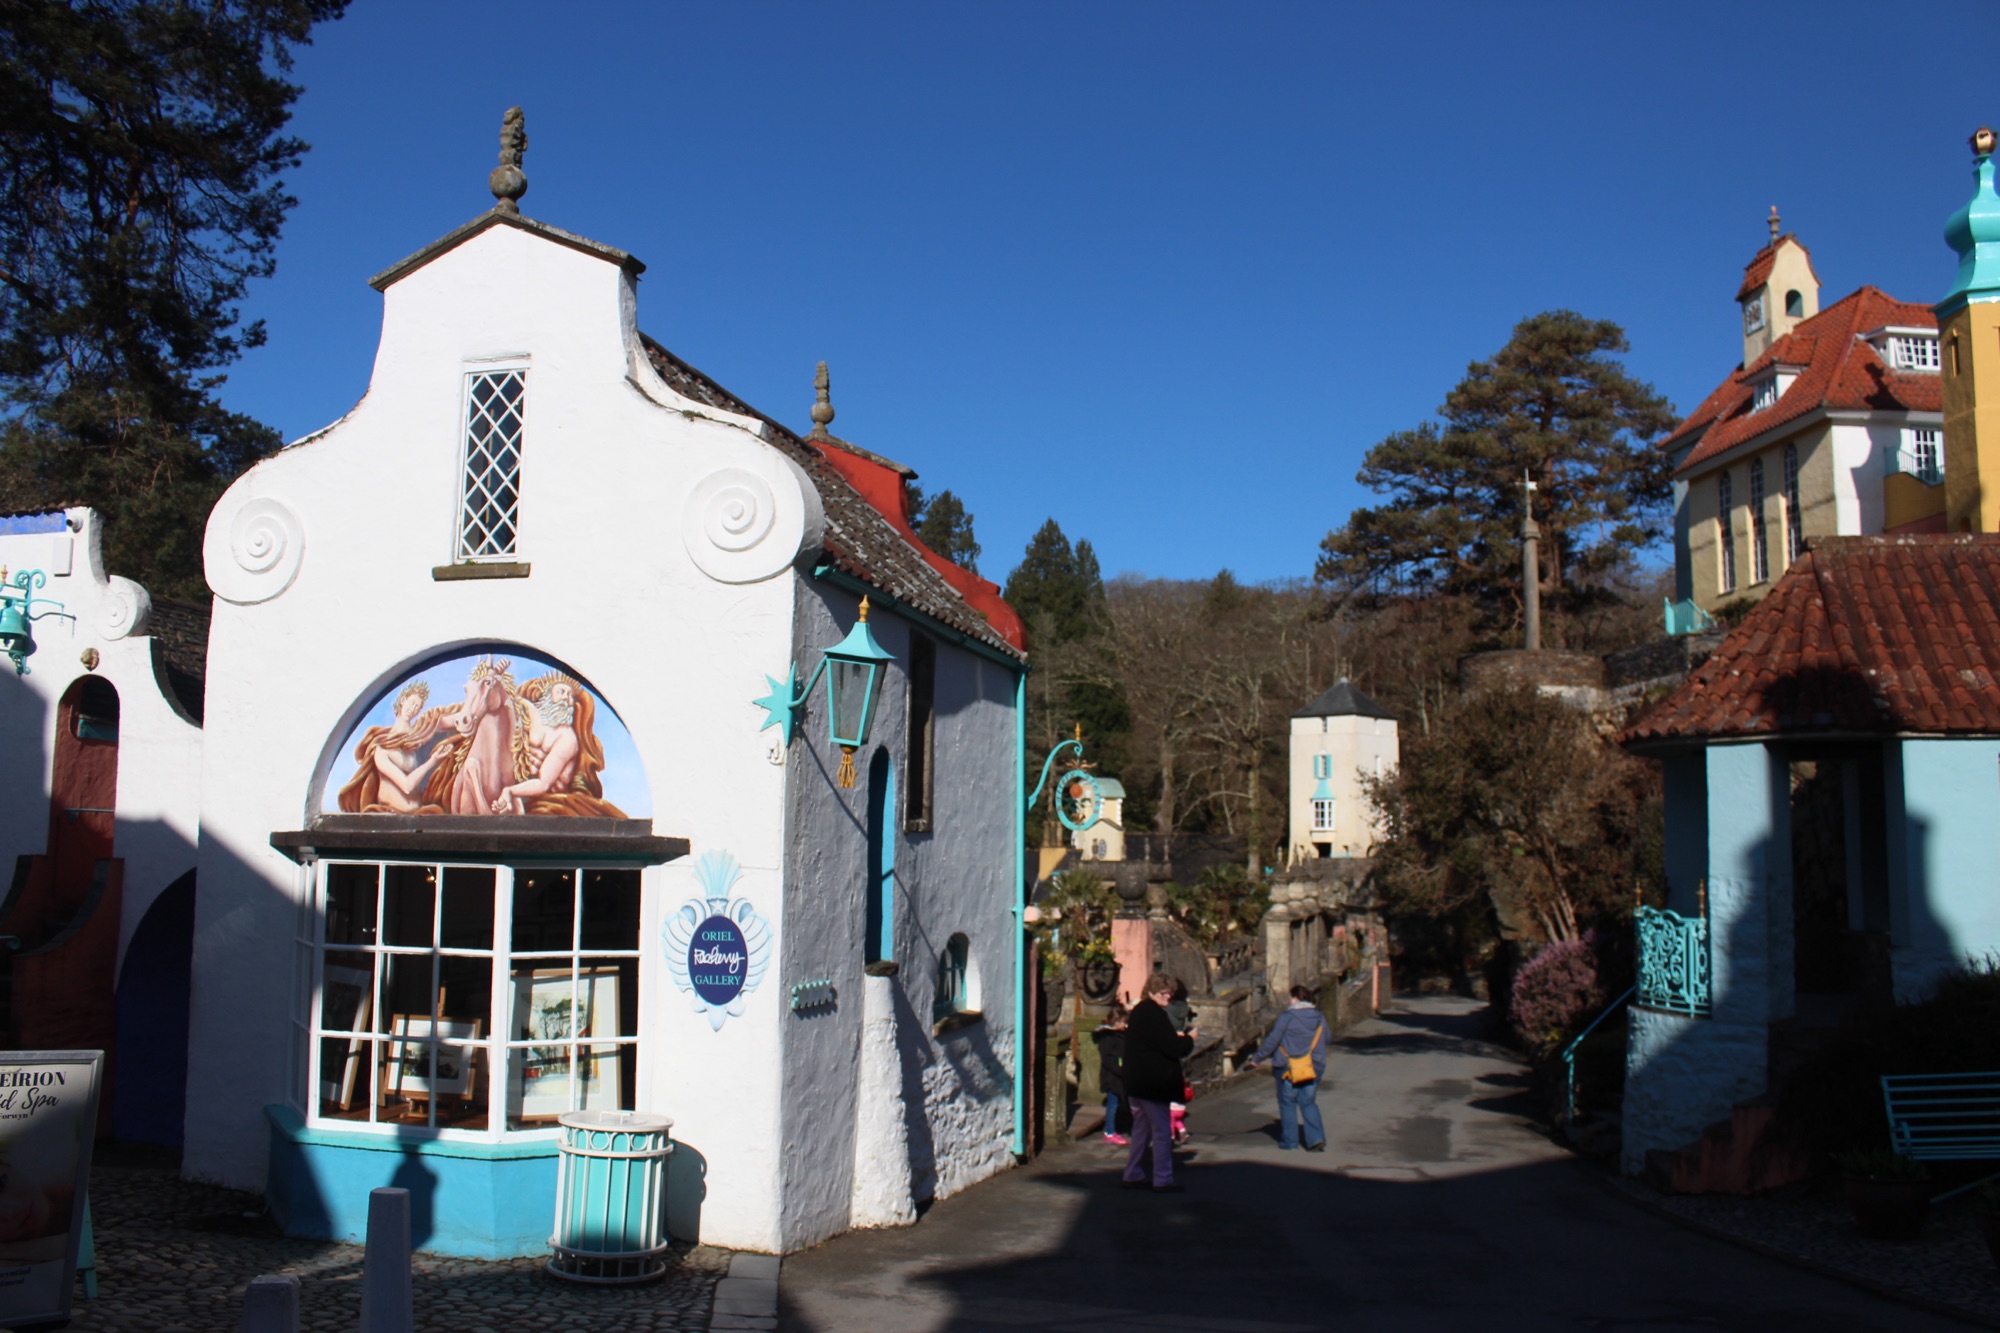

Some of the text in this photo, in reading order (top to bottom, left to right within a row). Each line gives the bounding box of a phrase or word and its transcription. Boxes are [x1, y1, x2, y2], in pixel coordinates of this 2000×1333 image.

[702, 931, 735, 941] ORIEL
[695, 975, 741, 985] GALLERY
[21, 1086, 60, 1116] Spa
